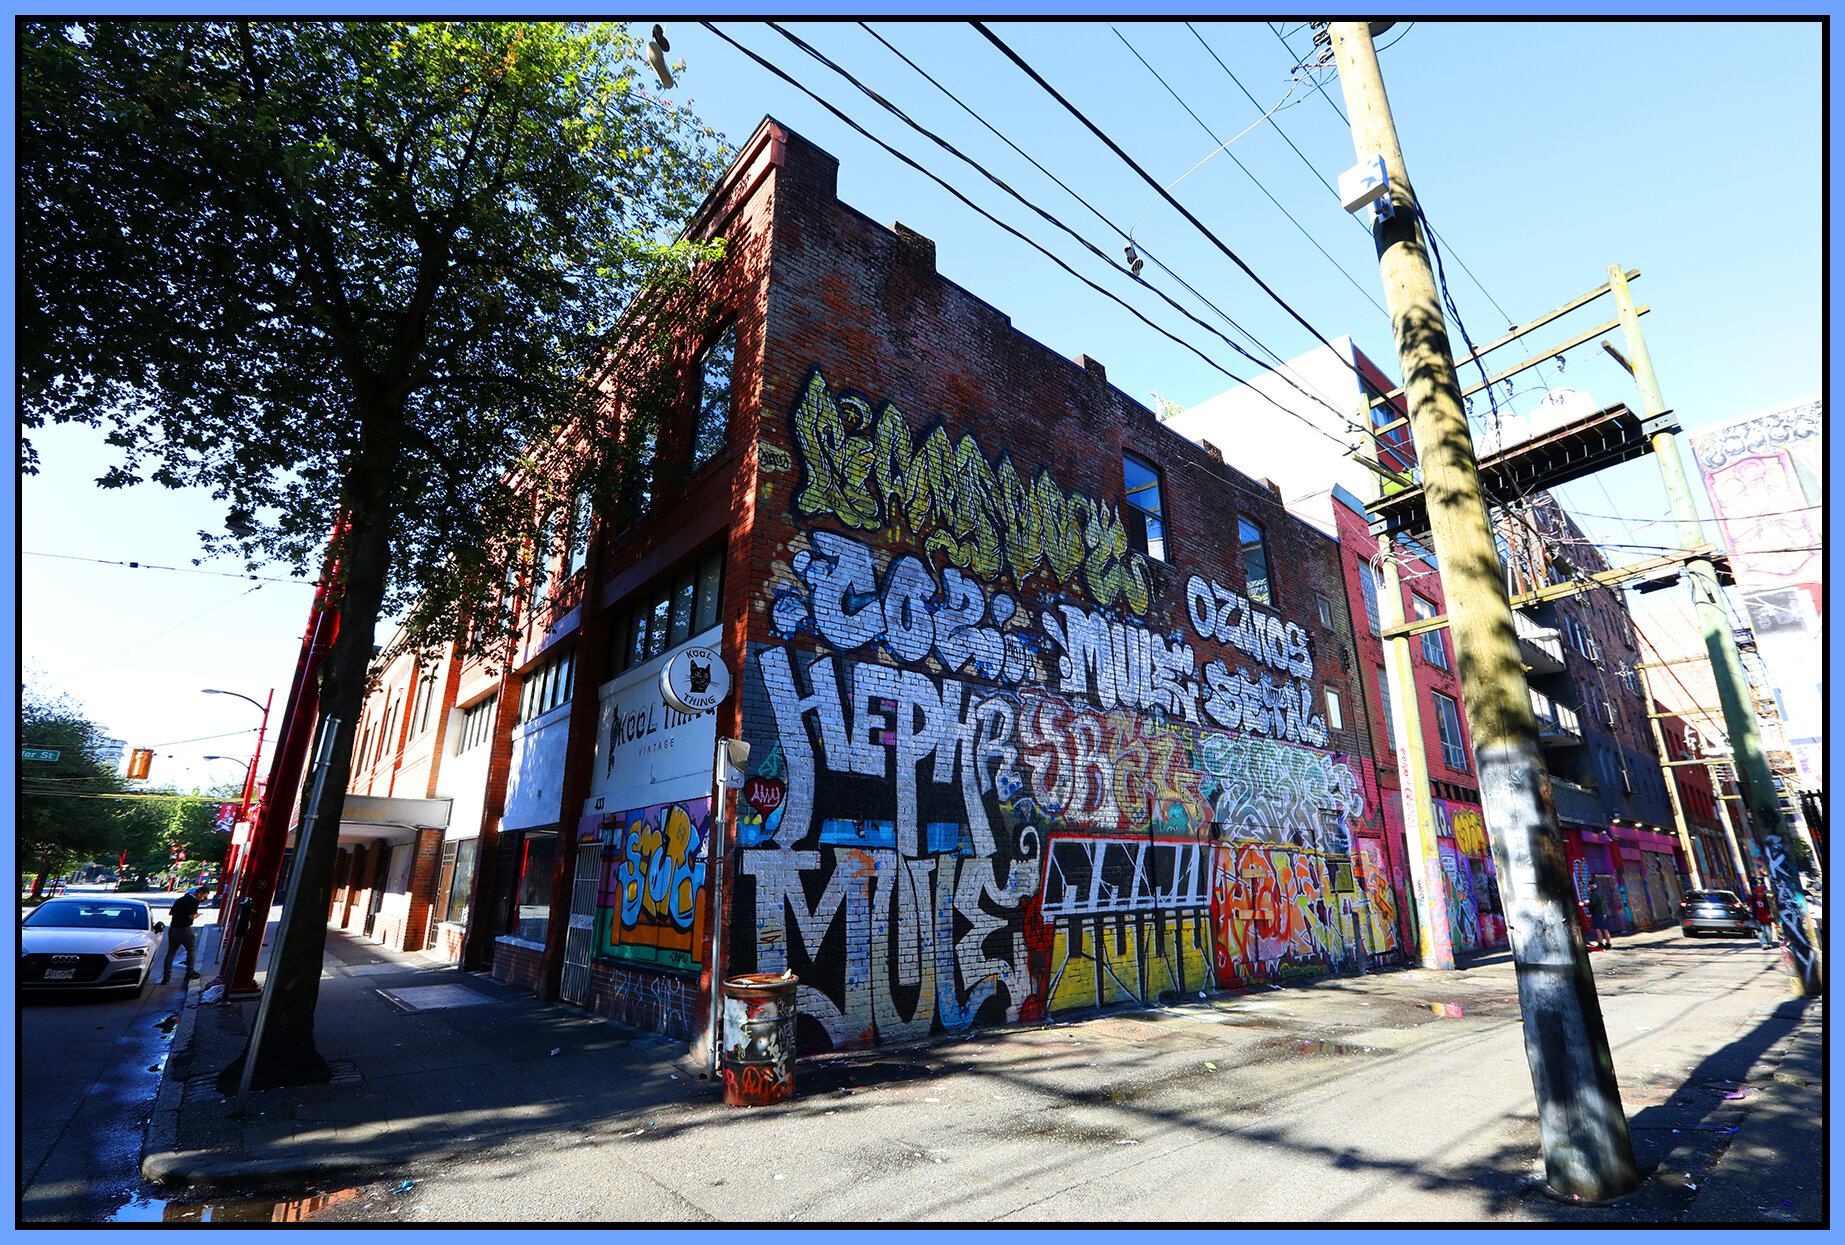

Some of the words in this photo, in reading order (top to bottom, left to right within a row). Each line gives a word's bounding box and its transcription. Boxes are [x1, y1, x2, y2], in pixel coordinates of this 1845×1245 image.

[686, 650, 713, 661] KOOL
[684, 692, 716, 706] THING
[615, 702, 658, 747] KOOL
[638, 737, 675, 756] VINTAGE
[40, 751, 54, 759] St
